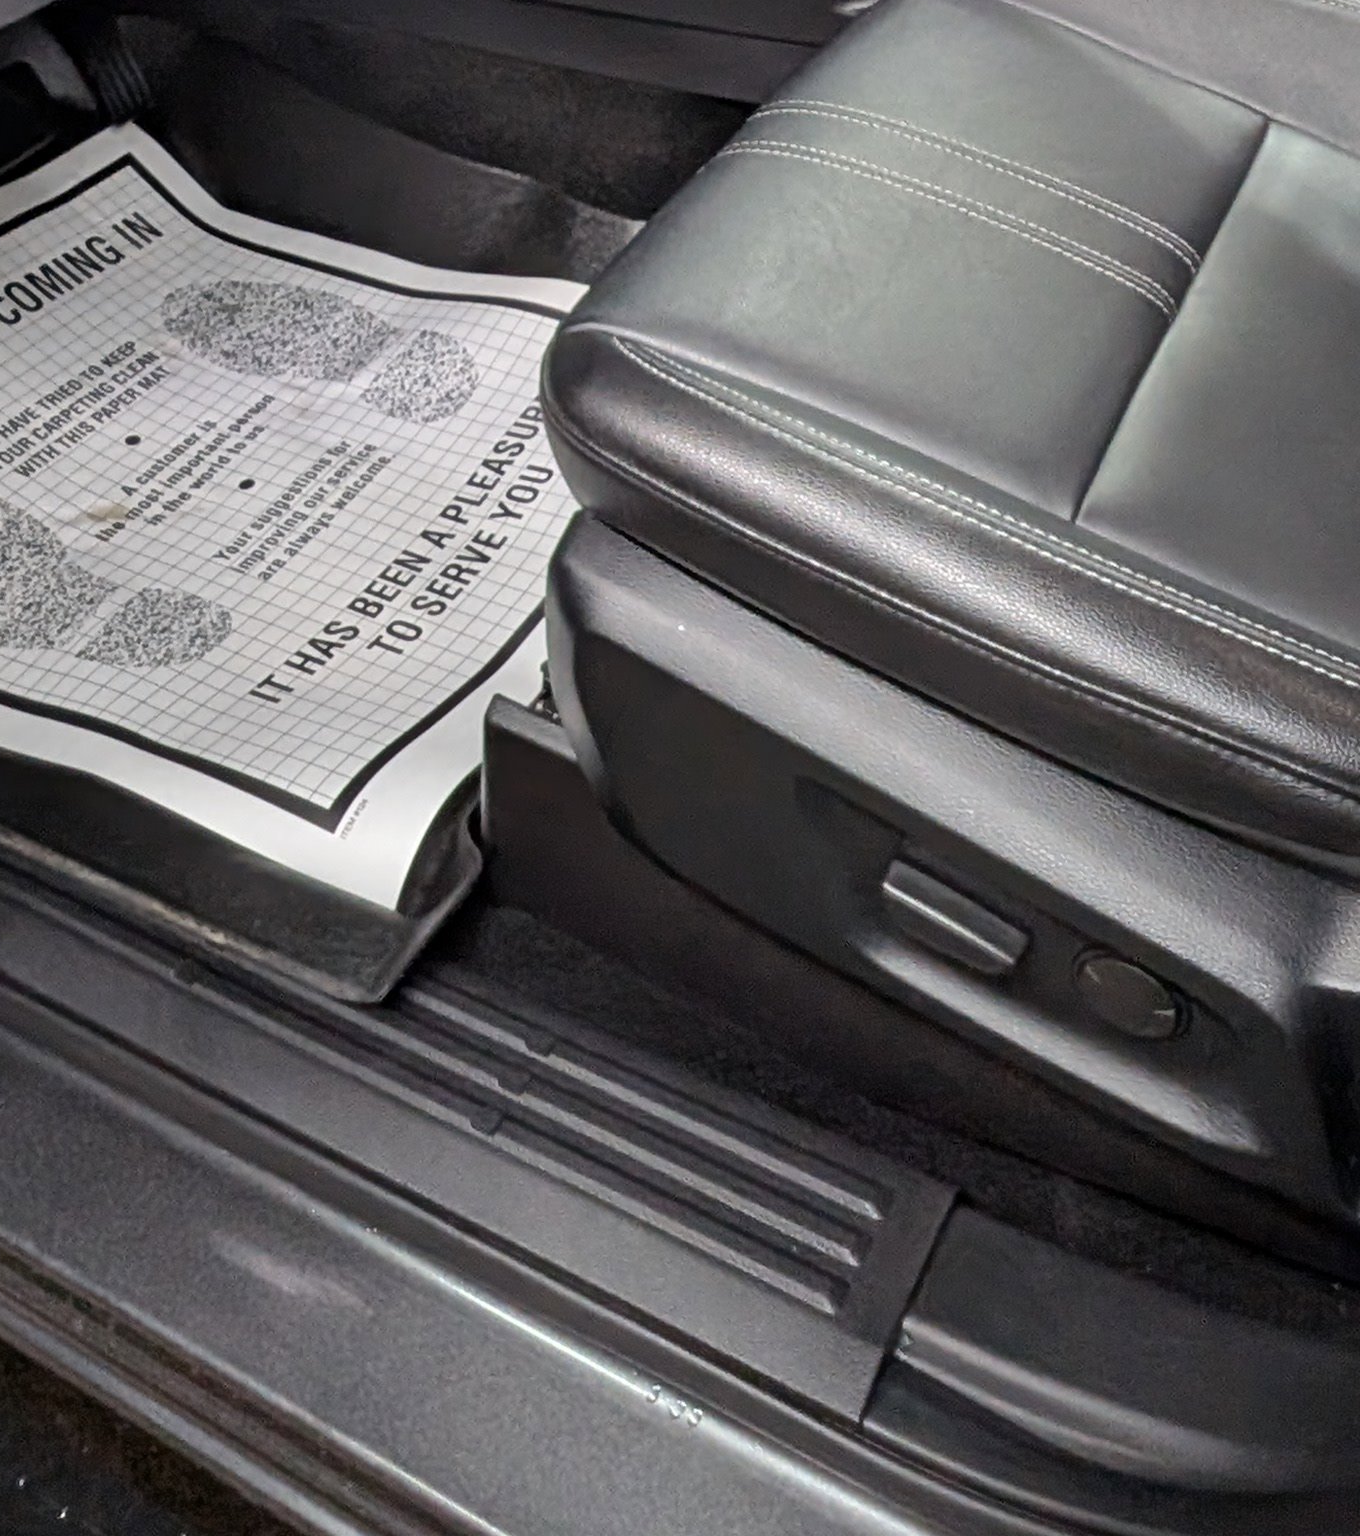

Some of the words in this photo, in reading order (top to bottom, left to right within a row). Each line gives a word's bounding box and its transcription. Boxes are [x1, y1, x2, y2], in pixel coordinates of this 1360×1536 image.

[112, 211, 164, 249] IN
[13, 447, 60, 478] WITH
[54, 422, 95, 452] THIS
[91, 387, 141, 424] PAPER
[136, 366, 171, 393] MAT
[31, 380, 116, 443] CARPETING
[110, 351, 160, 386] CLEAN
[35, 379, 83, 412] TRIED
[79, 364, 104, 383] TO
[100, 340, 136, 368] KEEP
[94, 521, 126, 543] the
[124, 486, 165, 521] most
[163, 430, 232, 491] important
[229, 394, 276, 436] person
[121, 484, 137, 497] A
[134, 435, 199, 486] customer
[197, 419, 218, 438] is
[144, 509, 167, 528] in
[162, 490, 191, 517] the
[189, 455, 231, 491] world
[227, 439, 247, 457] to
[212, 531, 253, 563] Your
[251, 455, 333, 535] suggestions
[328, 439, 353, 461] for
[235, 505, 309, 575] improving
[302, 484, 330, 510] our
[327, 441, 378, 487] service
[249, 673, 294, 704] IT
[283, 620, 361, 676] HAS
[347, 549, 432, 619] BEEN
[420, 528, 456, 550] A
[440, 394, 544, 527] PLEASUR
[256, 556, 286, 582] are
[283, 509, 336, 560] always
[366, 618, 423, 656] TO
[411, 528, 508, 617] SERVE
[489, 464, 554, 521] YOU
